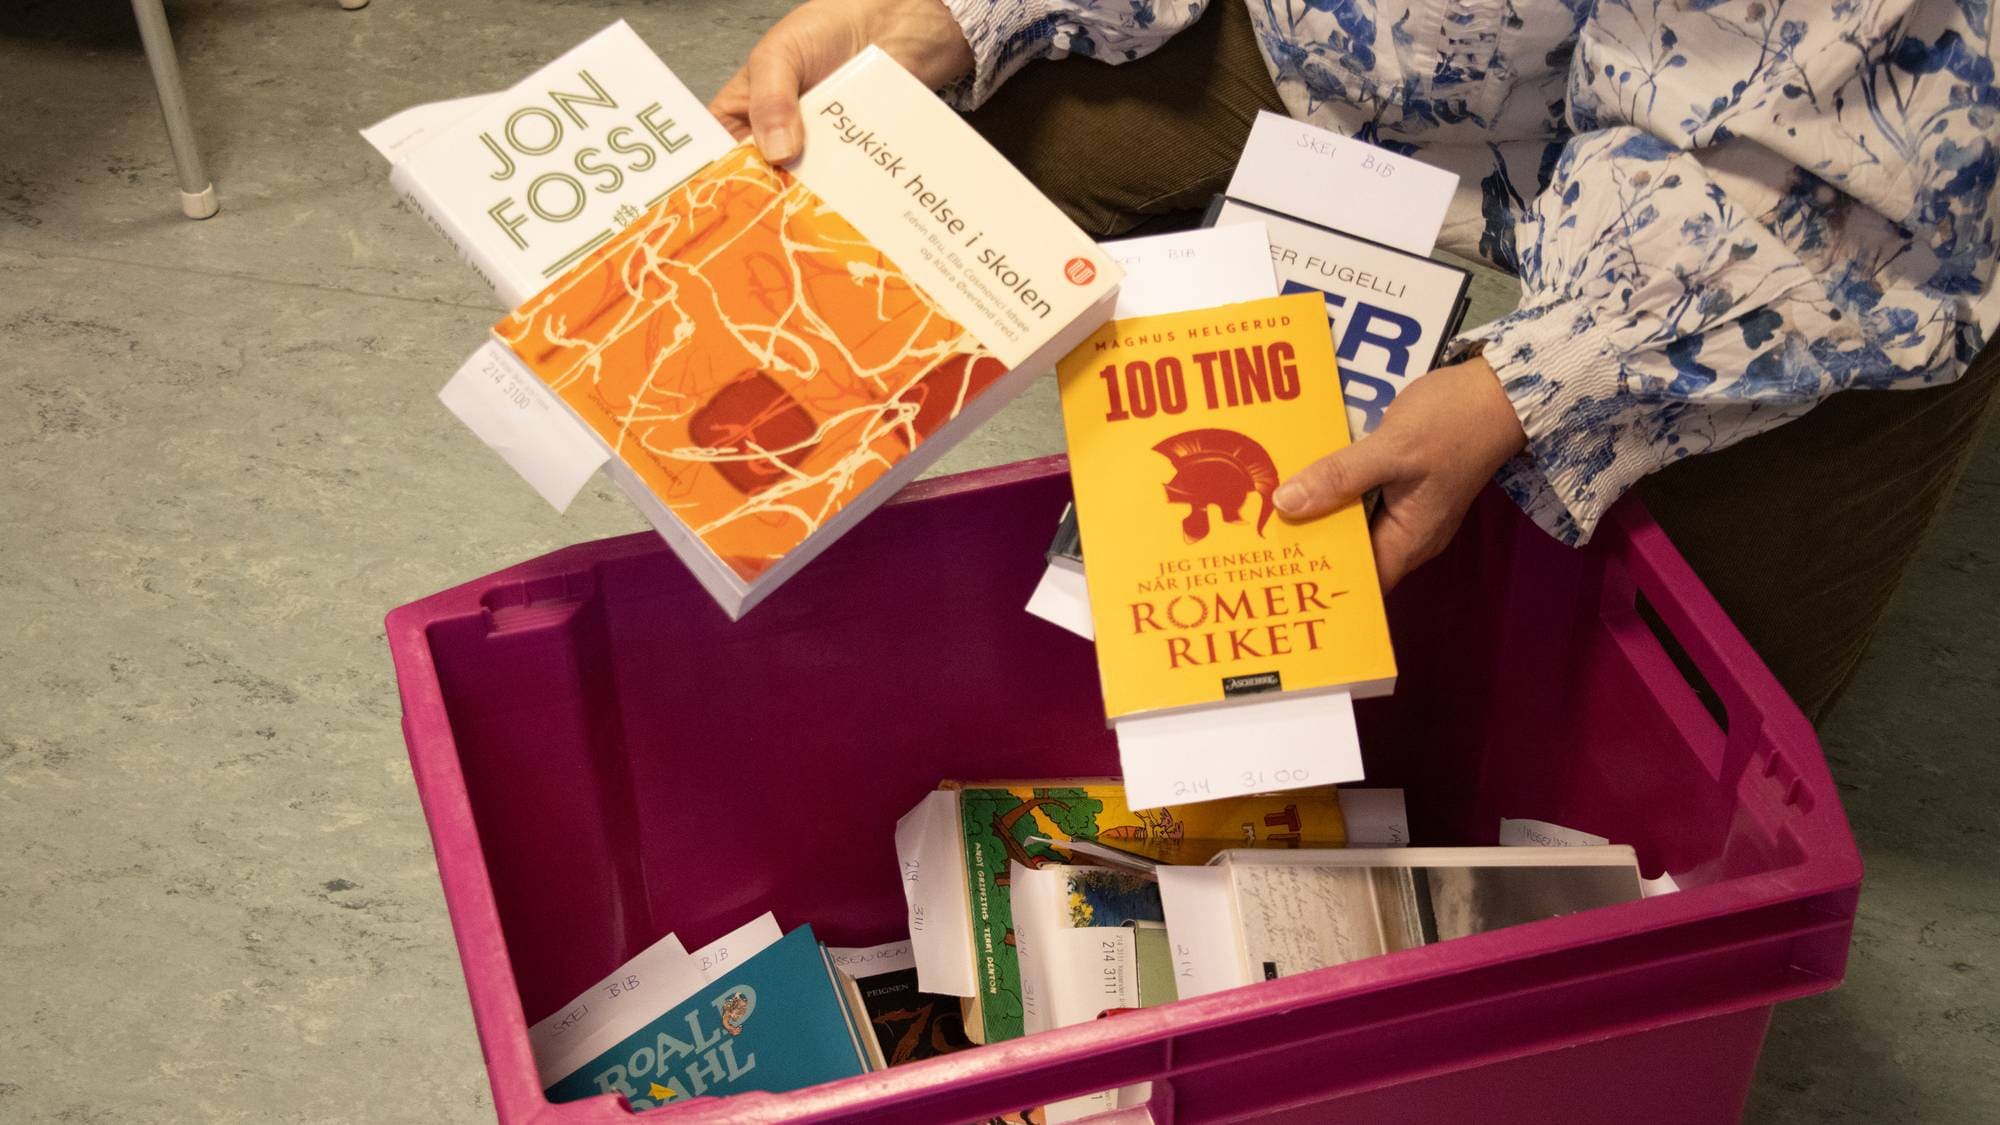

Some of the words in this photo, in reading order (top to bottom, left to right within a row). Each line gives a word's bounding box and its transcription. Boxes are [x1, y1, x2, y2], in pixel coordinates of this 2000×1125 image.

[479, 70, 619, 181] JON
[488, 102, 693, 251] FOSSE
[1296, 133, 1337, 159] SKEI
[1361, 154, 1396, 178] BIB
[819, 100, 906, 178] Psykisk
[904, 174, 966, 235] helse
[965, 231, 983, 248] i
[977, 246, 1052, 319] skolen
[1269, 244, 1298, 265] ER
[1305, 256, 1406, 299] FUGELLI
[1095, 331, 1175, 352] MAGNUS
[1188, 315, 1292, 339] HELGERUD
[1099, 356, 1188, 423] 100
[1193, 341, 1301, 411] TING
[1137, 574, 1178, 593] NÅR
[1185, 569, 1218, 590] JEG
[1224, 562, 1303, 585] TENKER
[1309, 555, 1332, 572] PÅ
[1158, 559, 1192, 577] JEG
[1197, 549, 1275, 572] TENKER
[1283, 544, 1306, 560] PÅ
[1167, 618, 1327, 669] RIKET
[1173, 777, 1211, 797] 214
[974, 842, 985, 868] ANDY
[977, 870, 989, 921] GRIFFITHS
[700, 948, 729, 971] BIB
[983, 927, 994, 954] TERRY
[1102, 941, 1116, 962] 214
[986, 956, 998, 995] DENTON
[1103, 968, 1117, 994] 3111
[552, 1003, 589, 1037] SKEI
[602, 974, 641, 1000] BIB
[593, 984, 757, 1097] ROALD
[631, 1039, 756, 1111] AHL
